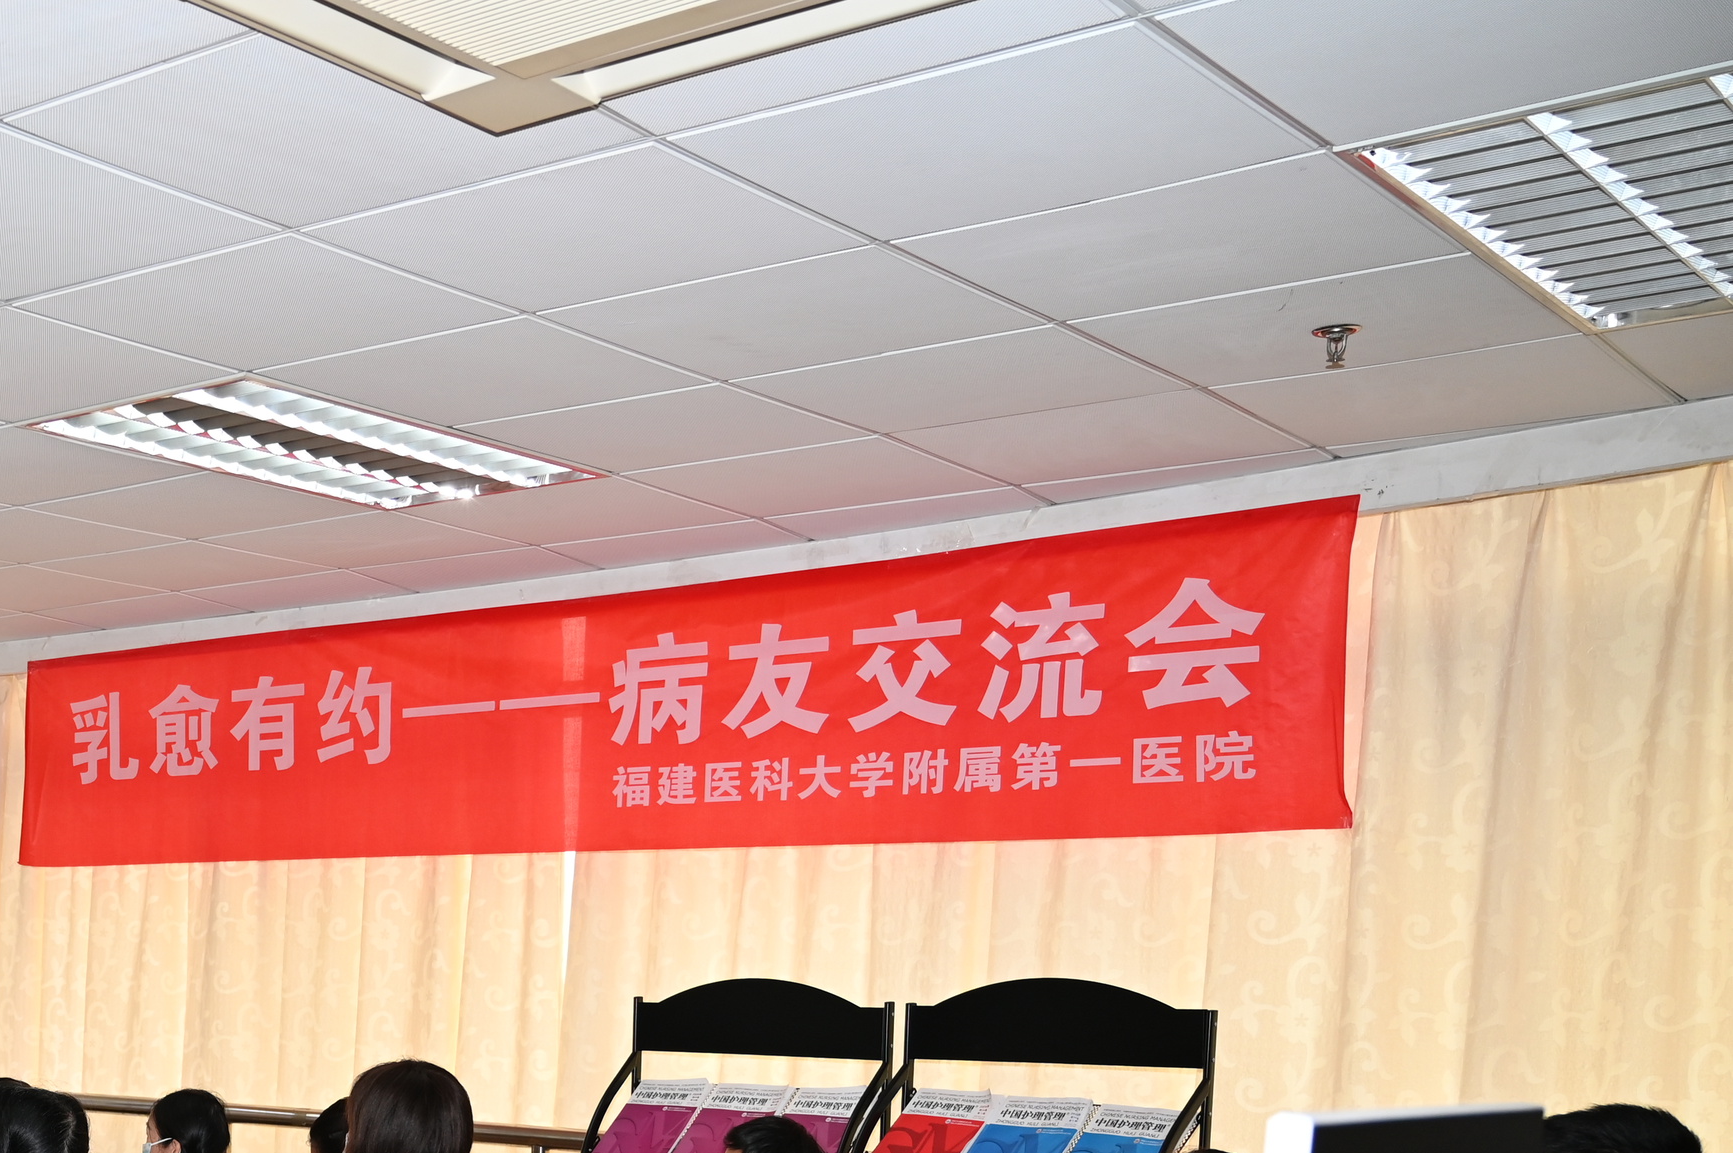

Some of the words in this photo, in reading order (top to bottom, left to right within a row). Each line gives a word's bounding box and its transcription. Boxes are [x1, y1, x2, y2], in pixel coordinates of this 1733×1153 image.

[70, 577, 1265, 785] 乳愈有约——病友交流会
[612, 730, 1257, 809] 福建医科大学附属第一医院
[912, 1100, 975, 1113] 中国护理管理
[1000, 1109, 1066, 1121] 中国护理管理
[1095, 1118, 1166, 1132] 中国护理管理
